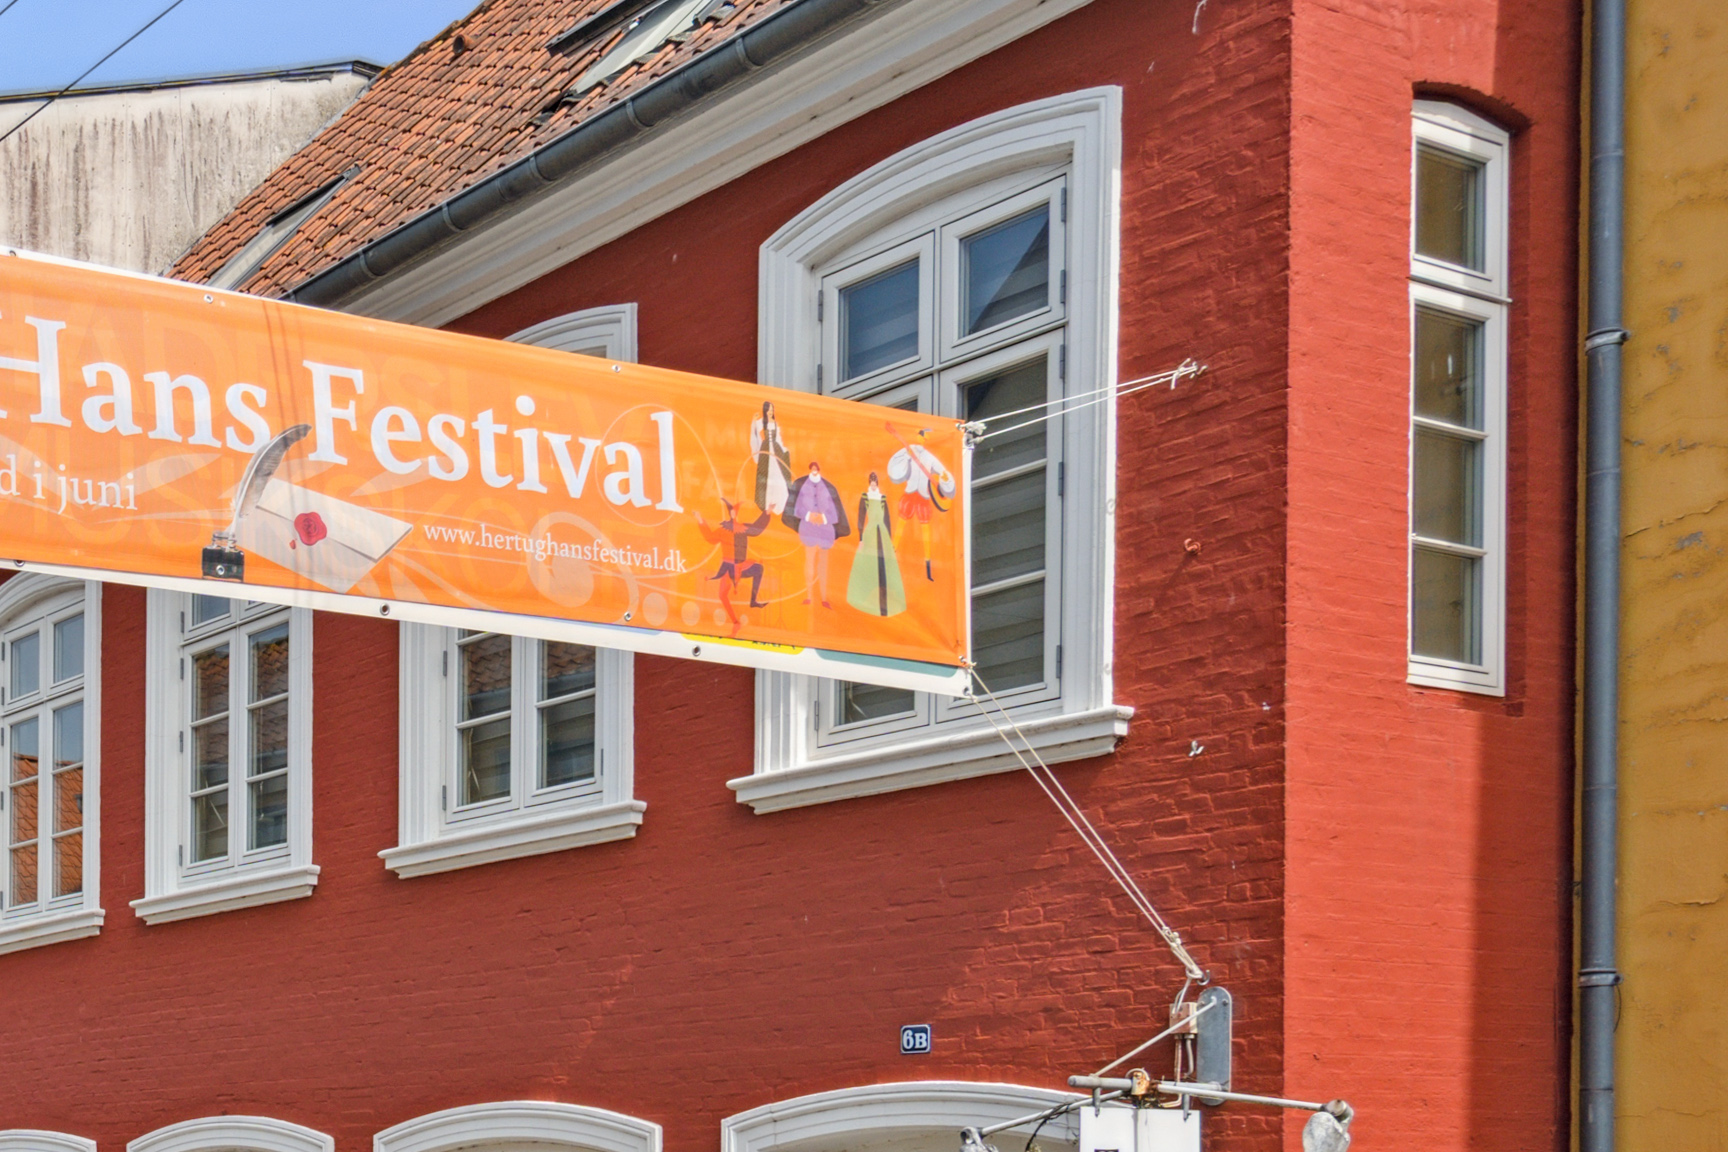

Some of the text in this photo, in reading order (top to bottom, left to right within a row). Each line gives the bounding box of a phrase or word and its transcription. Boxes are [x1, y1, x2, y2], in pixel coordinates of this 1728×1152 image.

[302, 359, 685, 514] Festival
[32, 460, 46, 499] i
[57, 463, 139, 514] juni
[423, 522, 688, 574] www.hertughansfestival.dk
[902, 1029, 929, 1050] 6B
